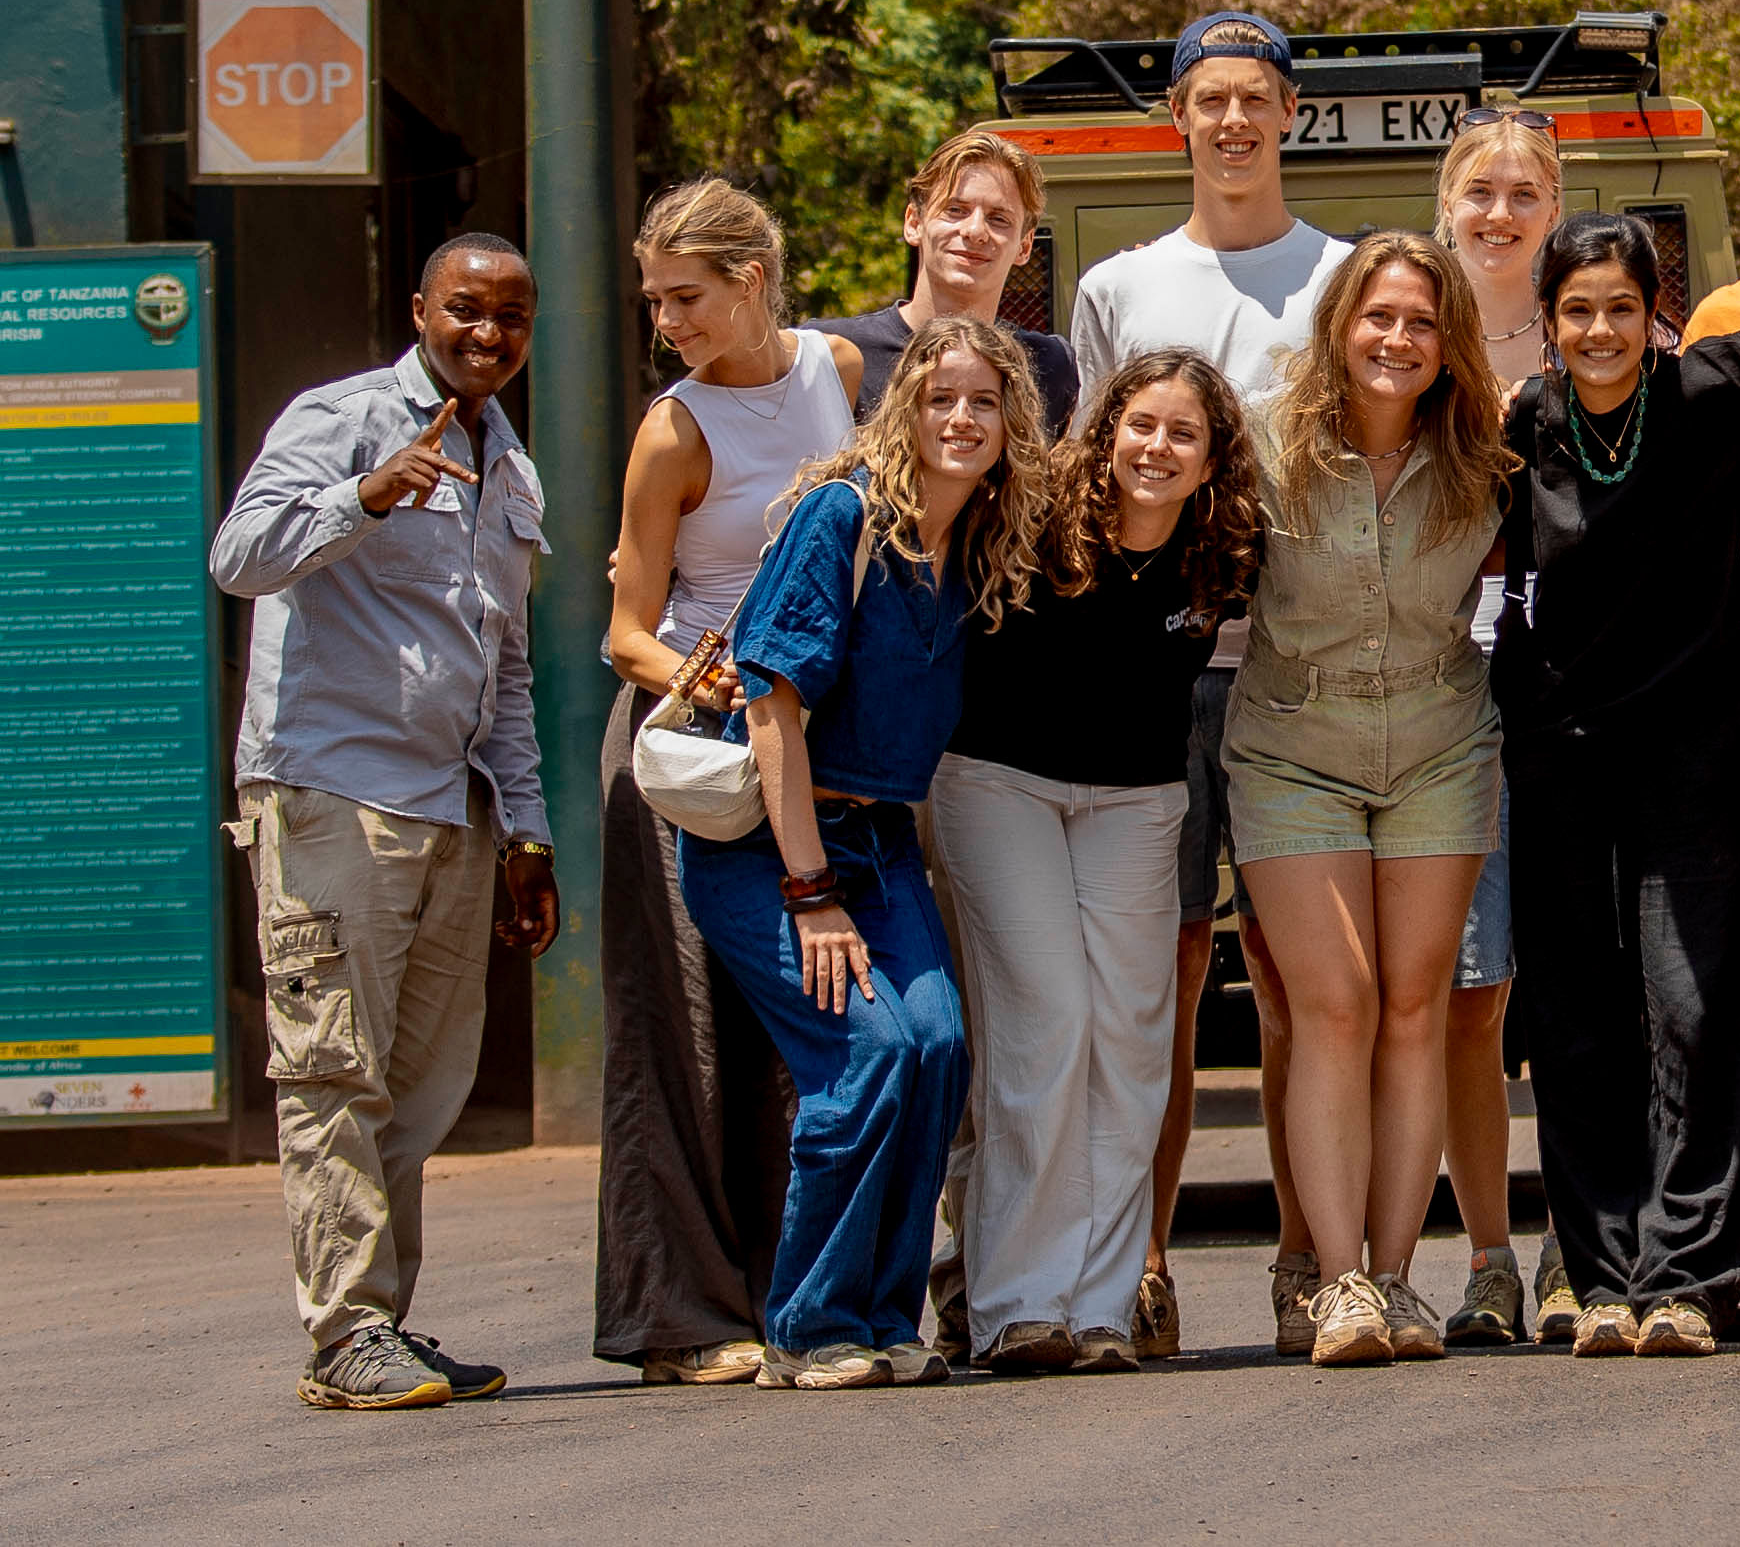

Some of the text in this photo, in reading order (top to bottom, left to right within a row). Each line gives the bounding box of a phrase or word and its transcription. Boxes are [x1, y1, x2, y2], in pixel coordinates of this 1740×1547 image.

[215, 62, 352, 107] STOP
[1280, 99, 1461, 145] 21 EKX
[21, 289, 43, 302] OF
[48, 286, 129, 302] TANZANIA
[27, 306, 128, 322] RESOURCES
[28, 1091, 108, 1110] WNDERS
